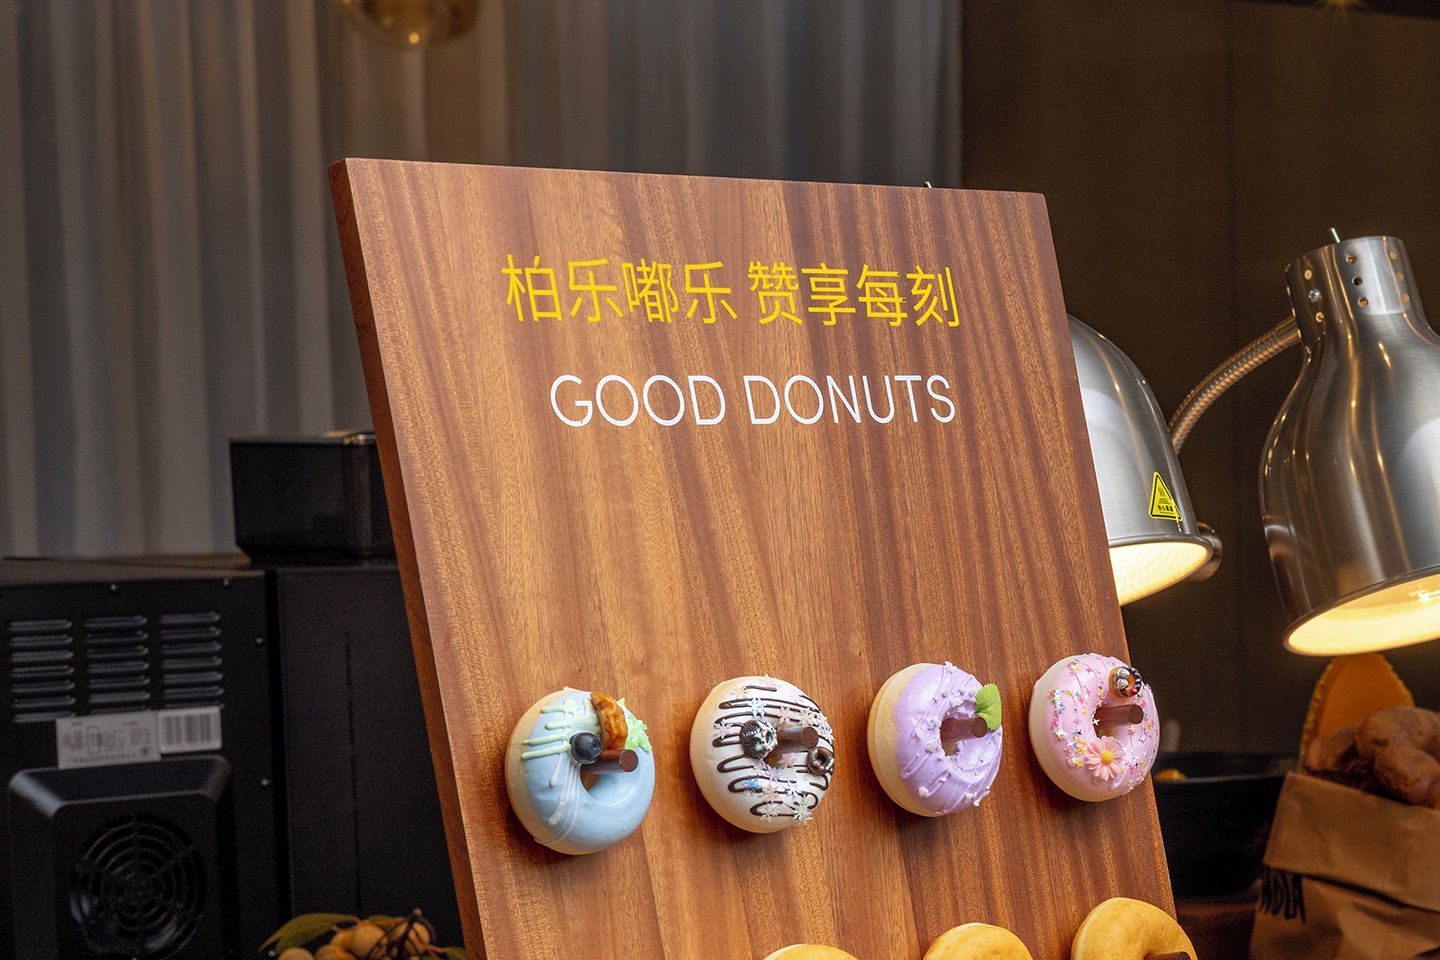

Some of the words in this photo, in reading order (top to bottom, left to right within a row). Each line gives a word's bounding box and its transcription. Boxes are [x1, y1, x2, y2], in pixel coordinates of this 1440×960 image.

[501, 254, 737, 324] 柏乐嘟乐
[748, 260, 961, 328] 赞享每刻
[550, 374, 726, 427] GOOD
[743, 375, 957, 426] DONUTS
